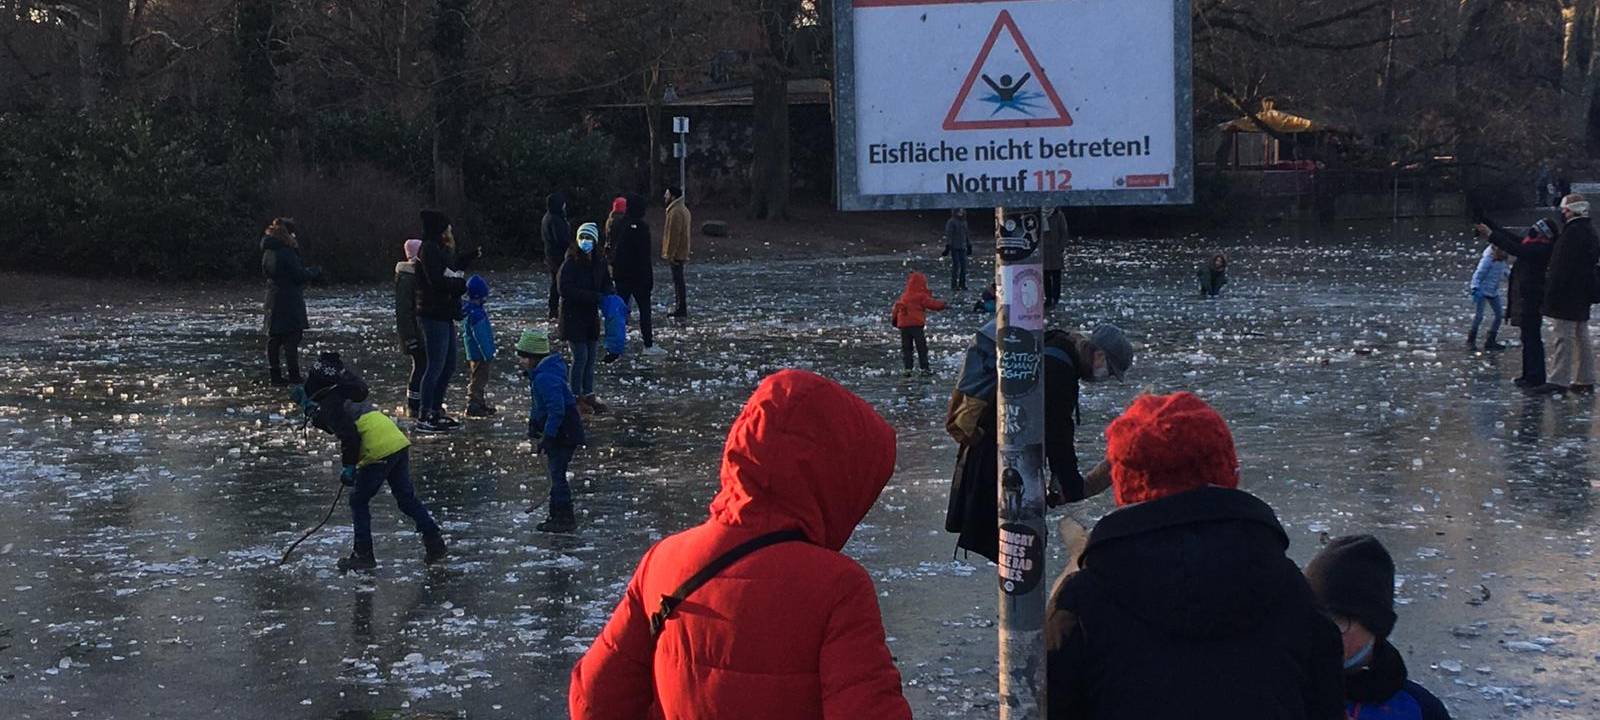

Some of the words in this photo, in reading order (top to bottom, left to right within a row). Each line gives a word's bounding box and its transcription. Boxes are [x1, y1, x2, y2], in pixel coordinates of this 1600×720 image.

[869, 141, 968, 164] Eisfläche
[975, 138, 1032, 160] nicht
[1040, 136, 1150, 159] betreten!
[946, 170, 1027, 193] Notruf
[1033, 170, 1073, 192] 112
